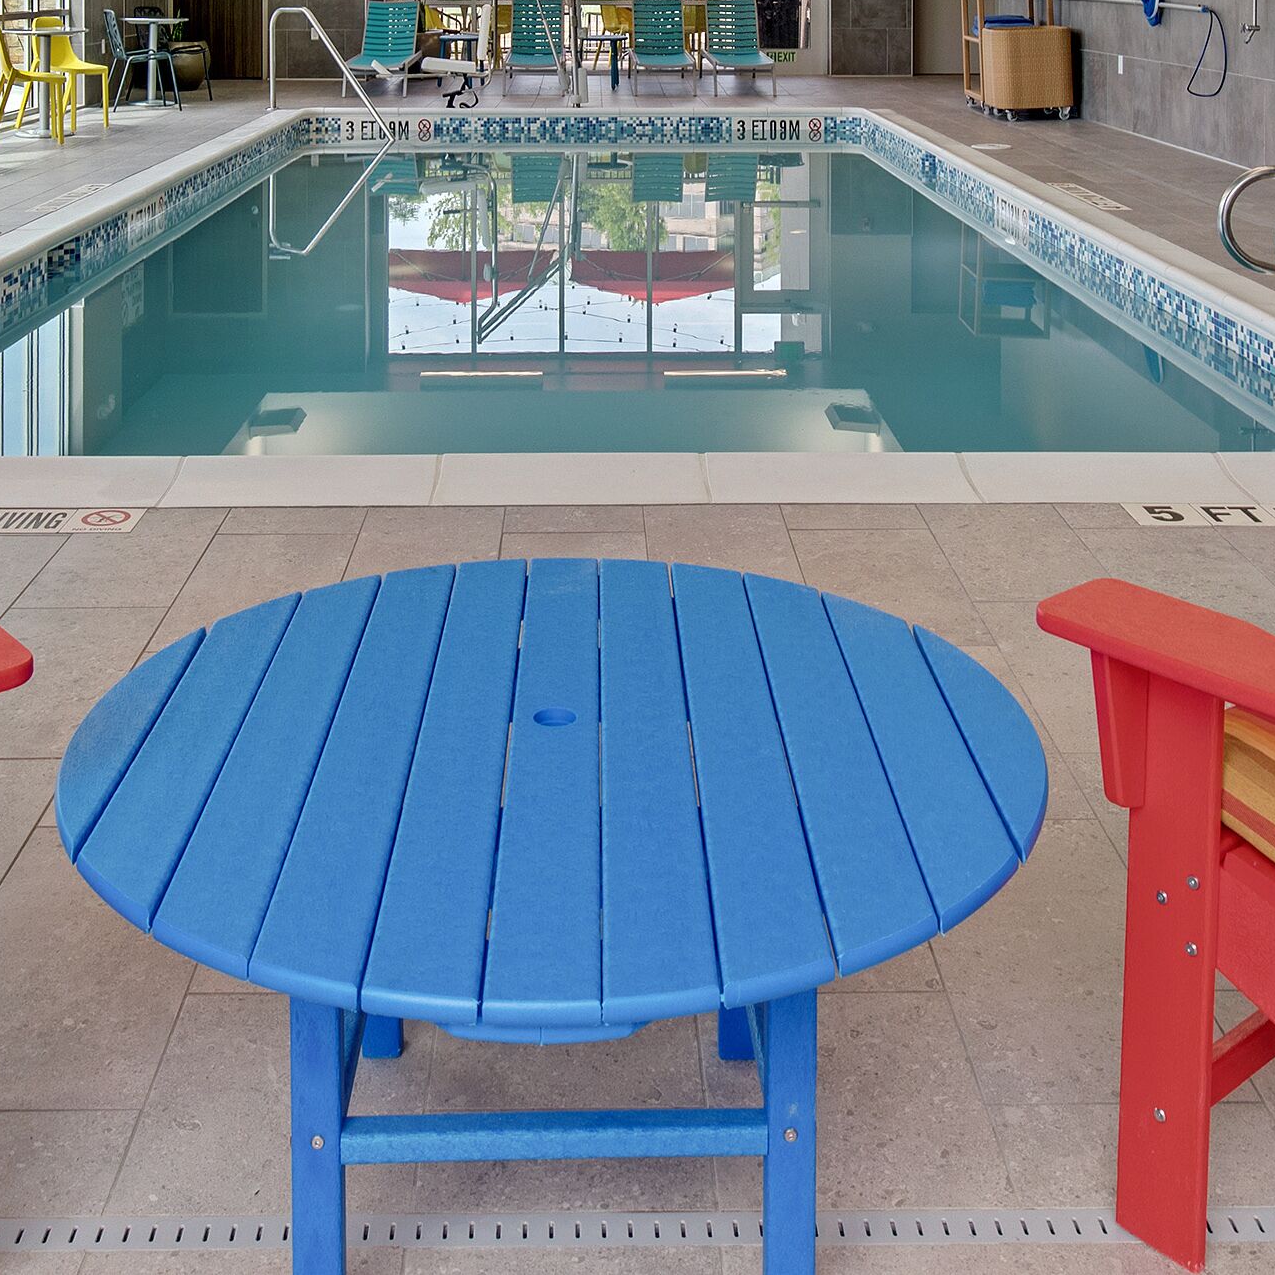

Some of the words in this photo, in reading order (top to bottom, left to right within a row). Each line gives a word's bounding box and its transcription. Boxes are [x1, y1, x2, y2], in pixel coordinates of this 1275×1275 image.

[778, 52, 796, 62] EXIT
[1142, 505, 1185, 522] 5
[1200, 506, 1262, 522] FT
